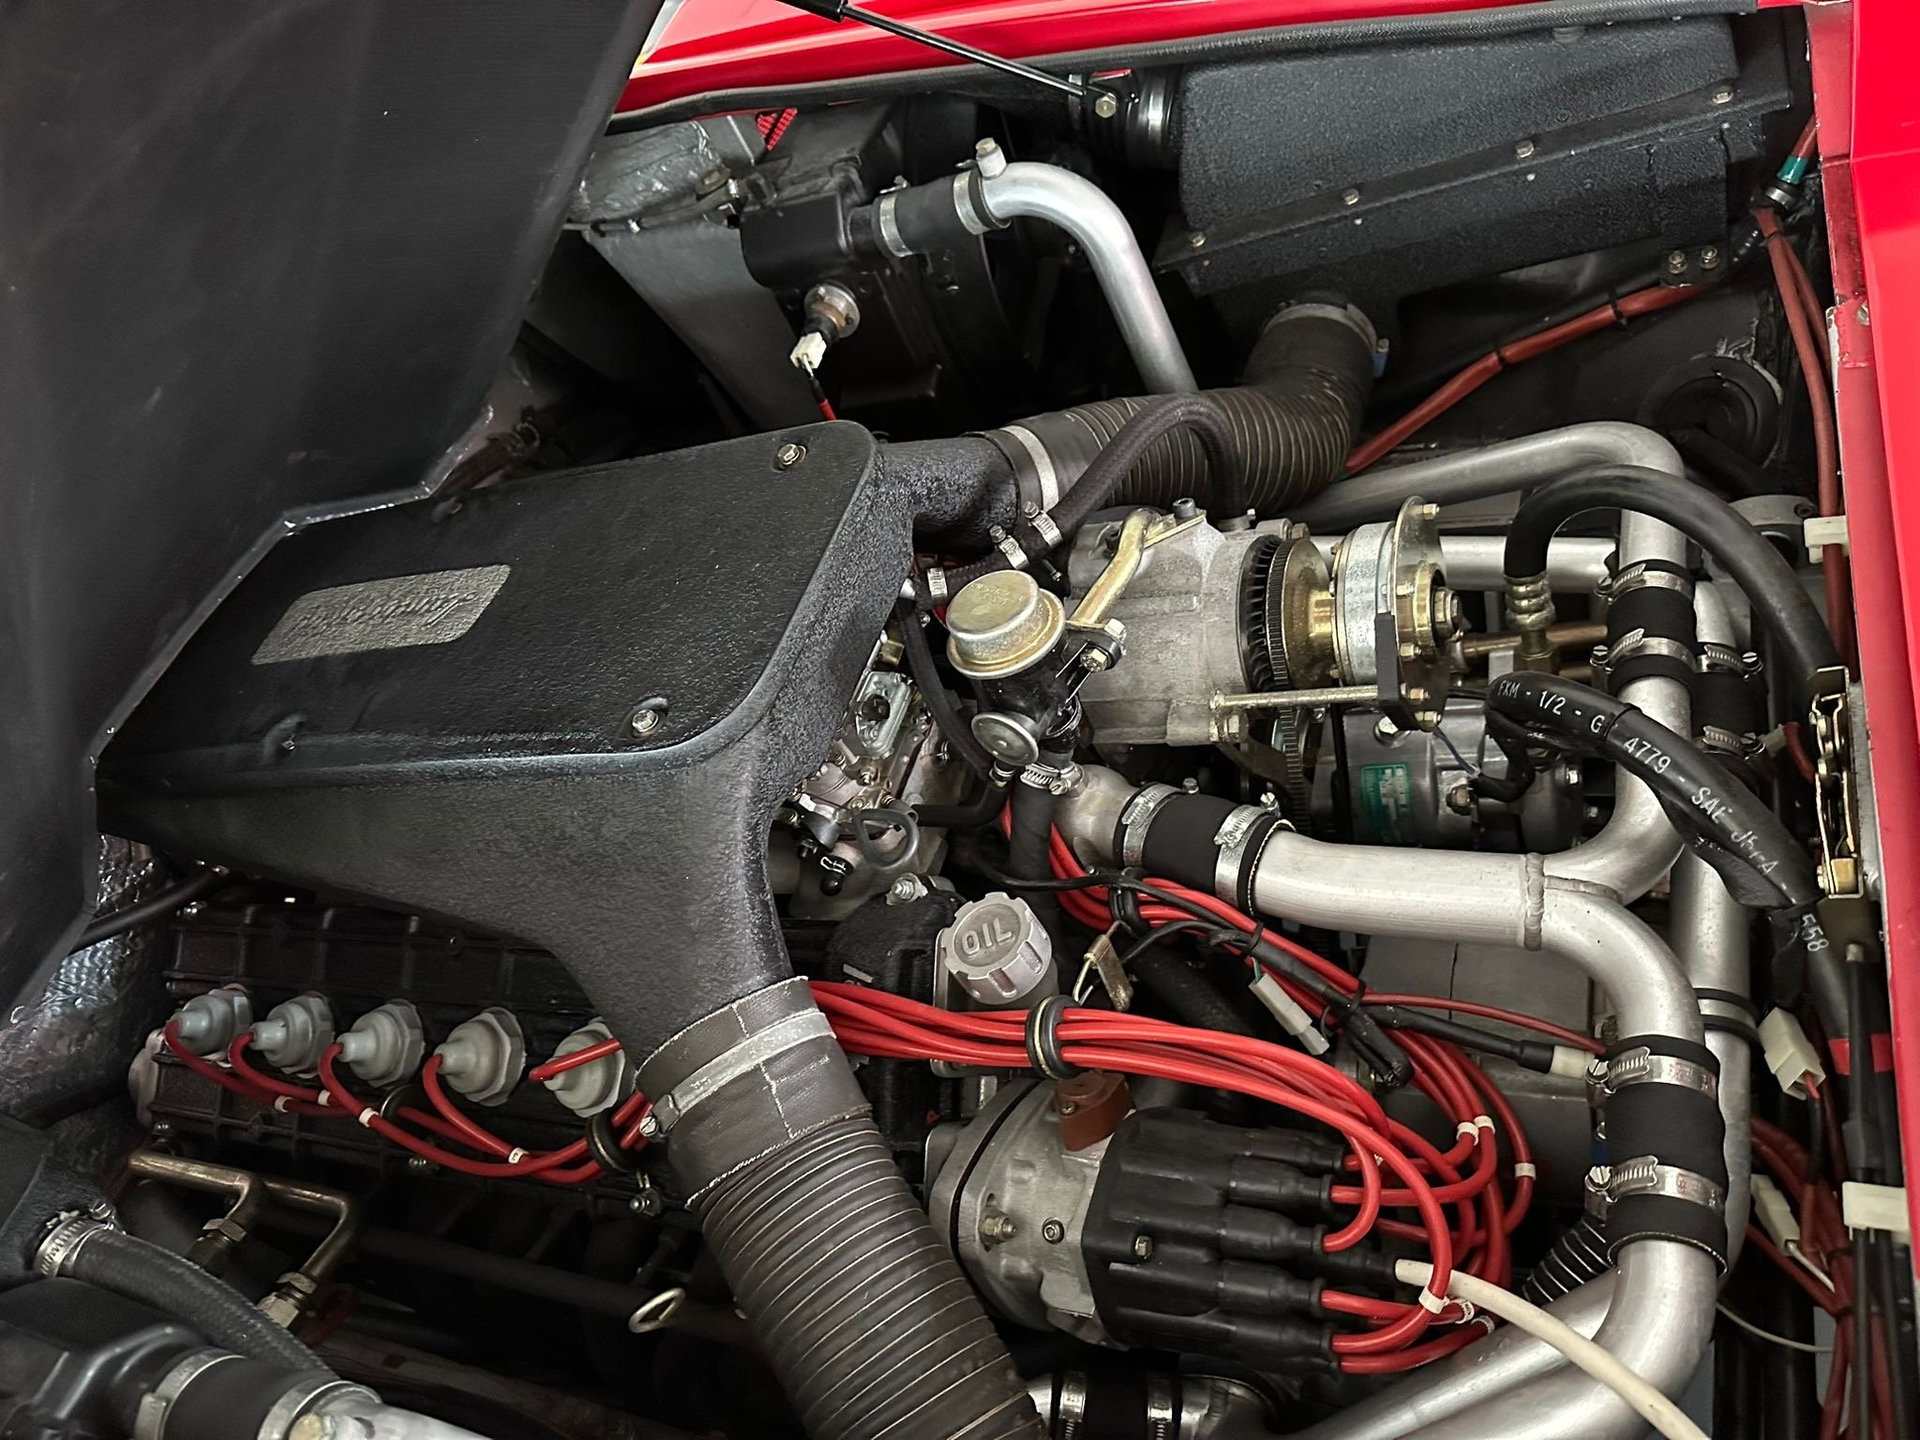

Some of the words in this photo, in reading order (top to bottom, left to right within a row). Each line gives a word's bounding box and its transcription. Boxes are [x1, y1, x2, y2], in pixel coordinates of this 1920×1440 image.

[1539, 690, 1567, 716] 1/2
[1590, 714, 1605, 734] G
[1623, 737, 1672, 774] 4779
[961, 917, 1014, 957] OIL
